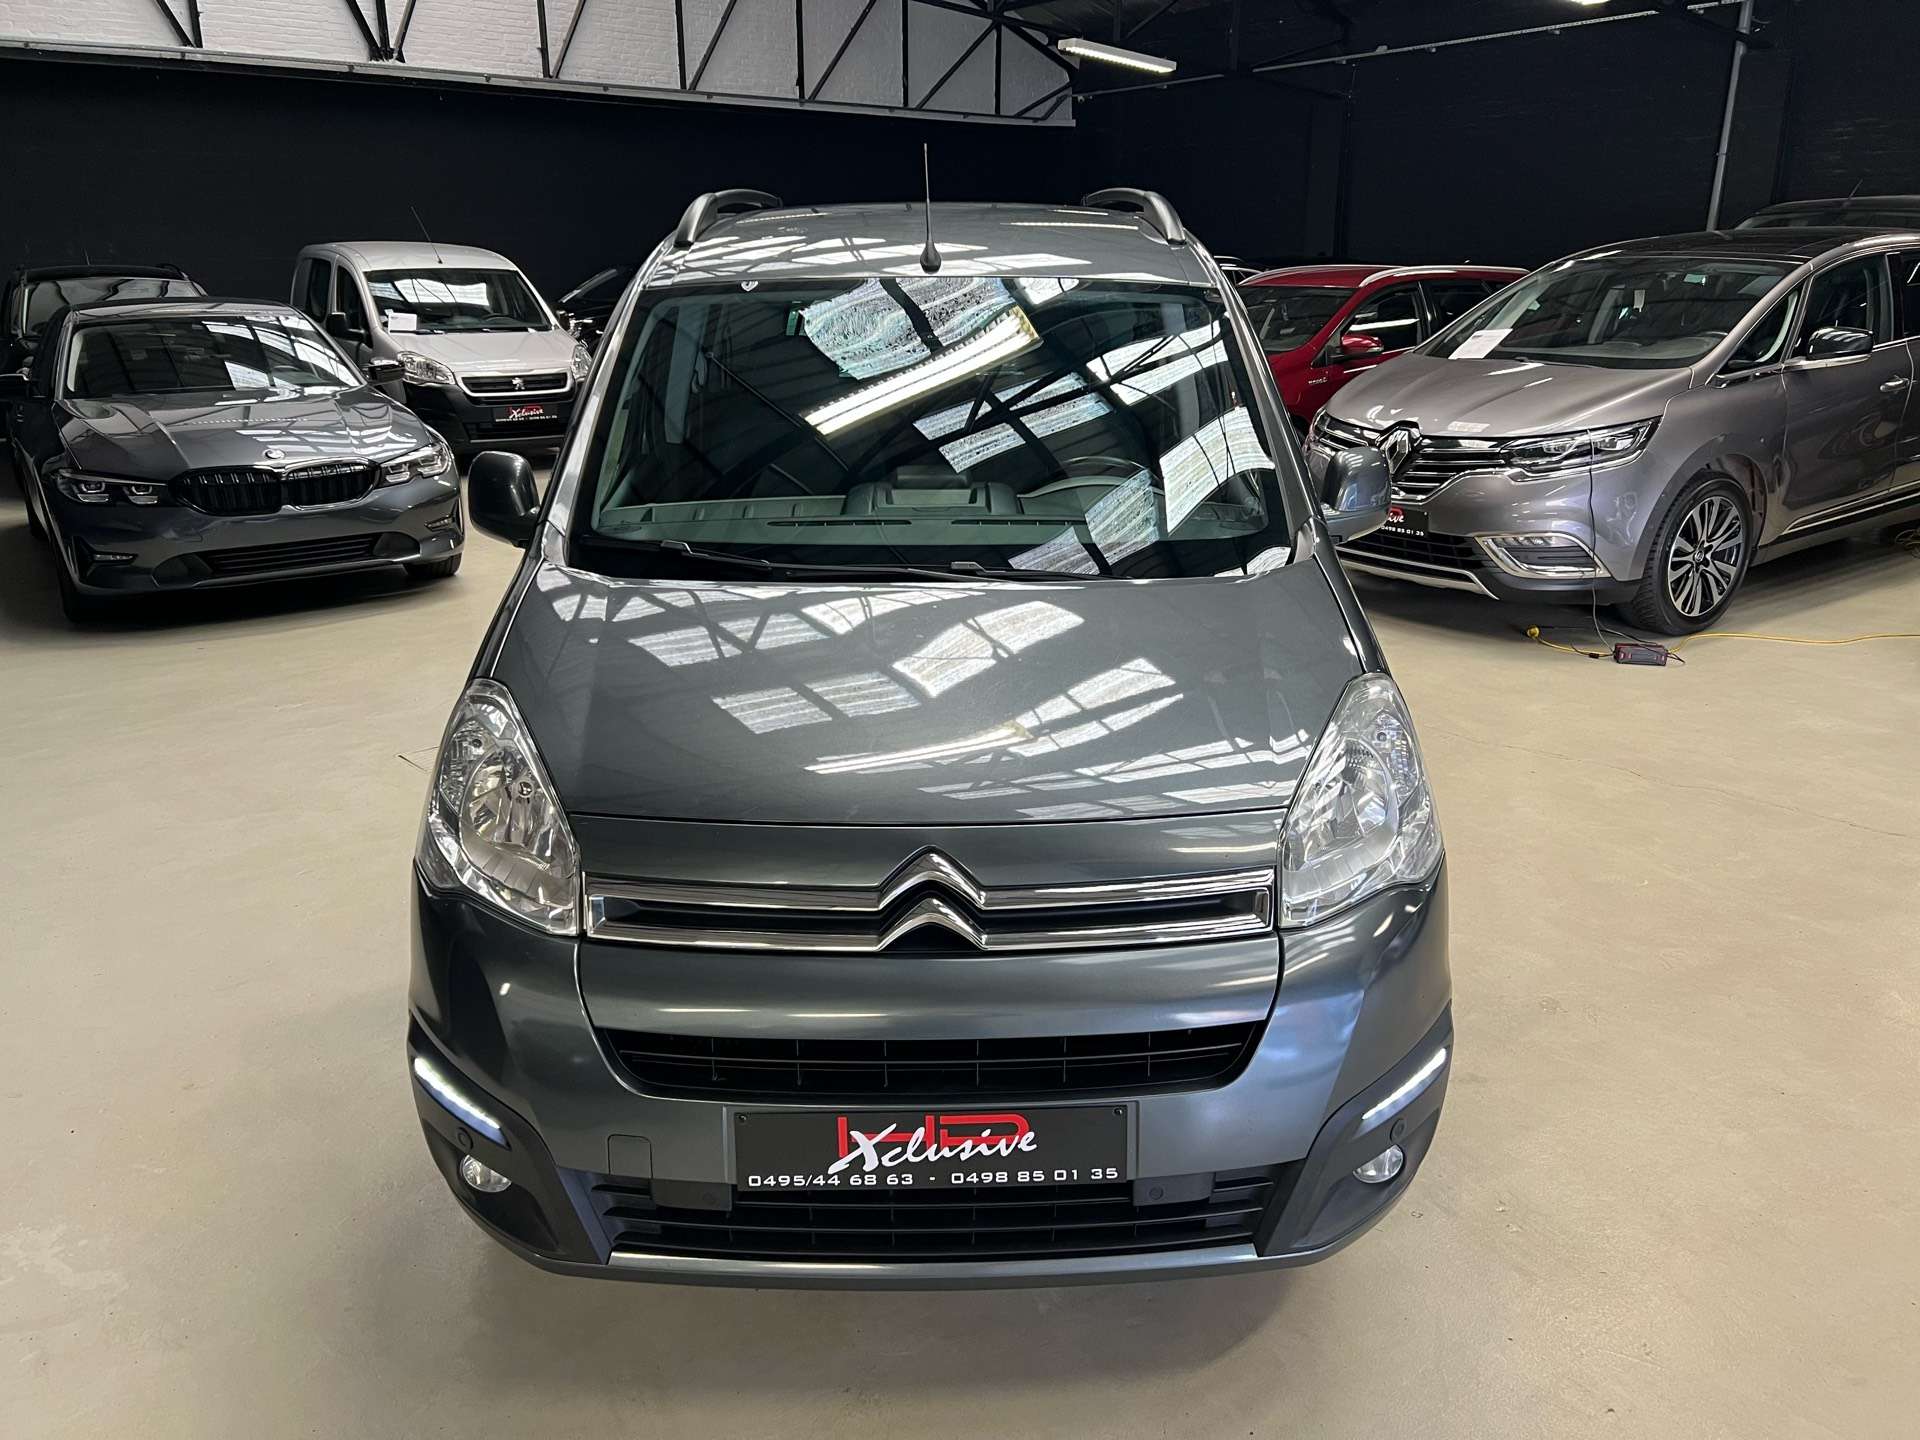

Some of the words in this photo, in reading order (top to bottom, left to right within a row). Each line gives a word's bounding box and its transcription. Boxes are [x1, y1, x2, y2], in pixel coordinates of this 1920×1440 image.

[827, 1122, 1038, 1175] Xclusive
[748, 1173, 841, 1187] 0495/44
[849, 1174, 877, 1186] 68
[886, 1173, 914, 1186] 63
[951, 1171, 1008, 1184] 0498
[1017, 1170, 1045, 1182] 85
[1054, 1168, 1078, 1181] 01
[1090, 1167, 1119, 1180] 35
